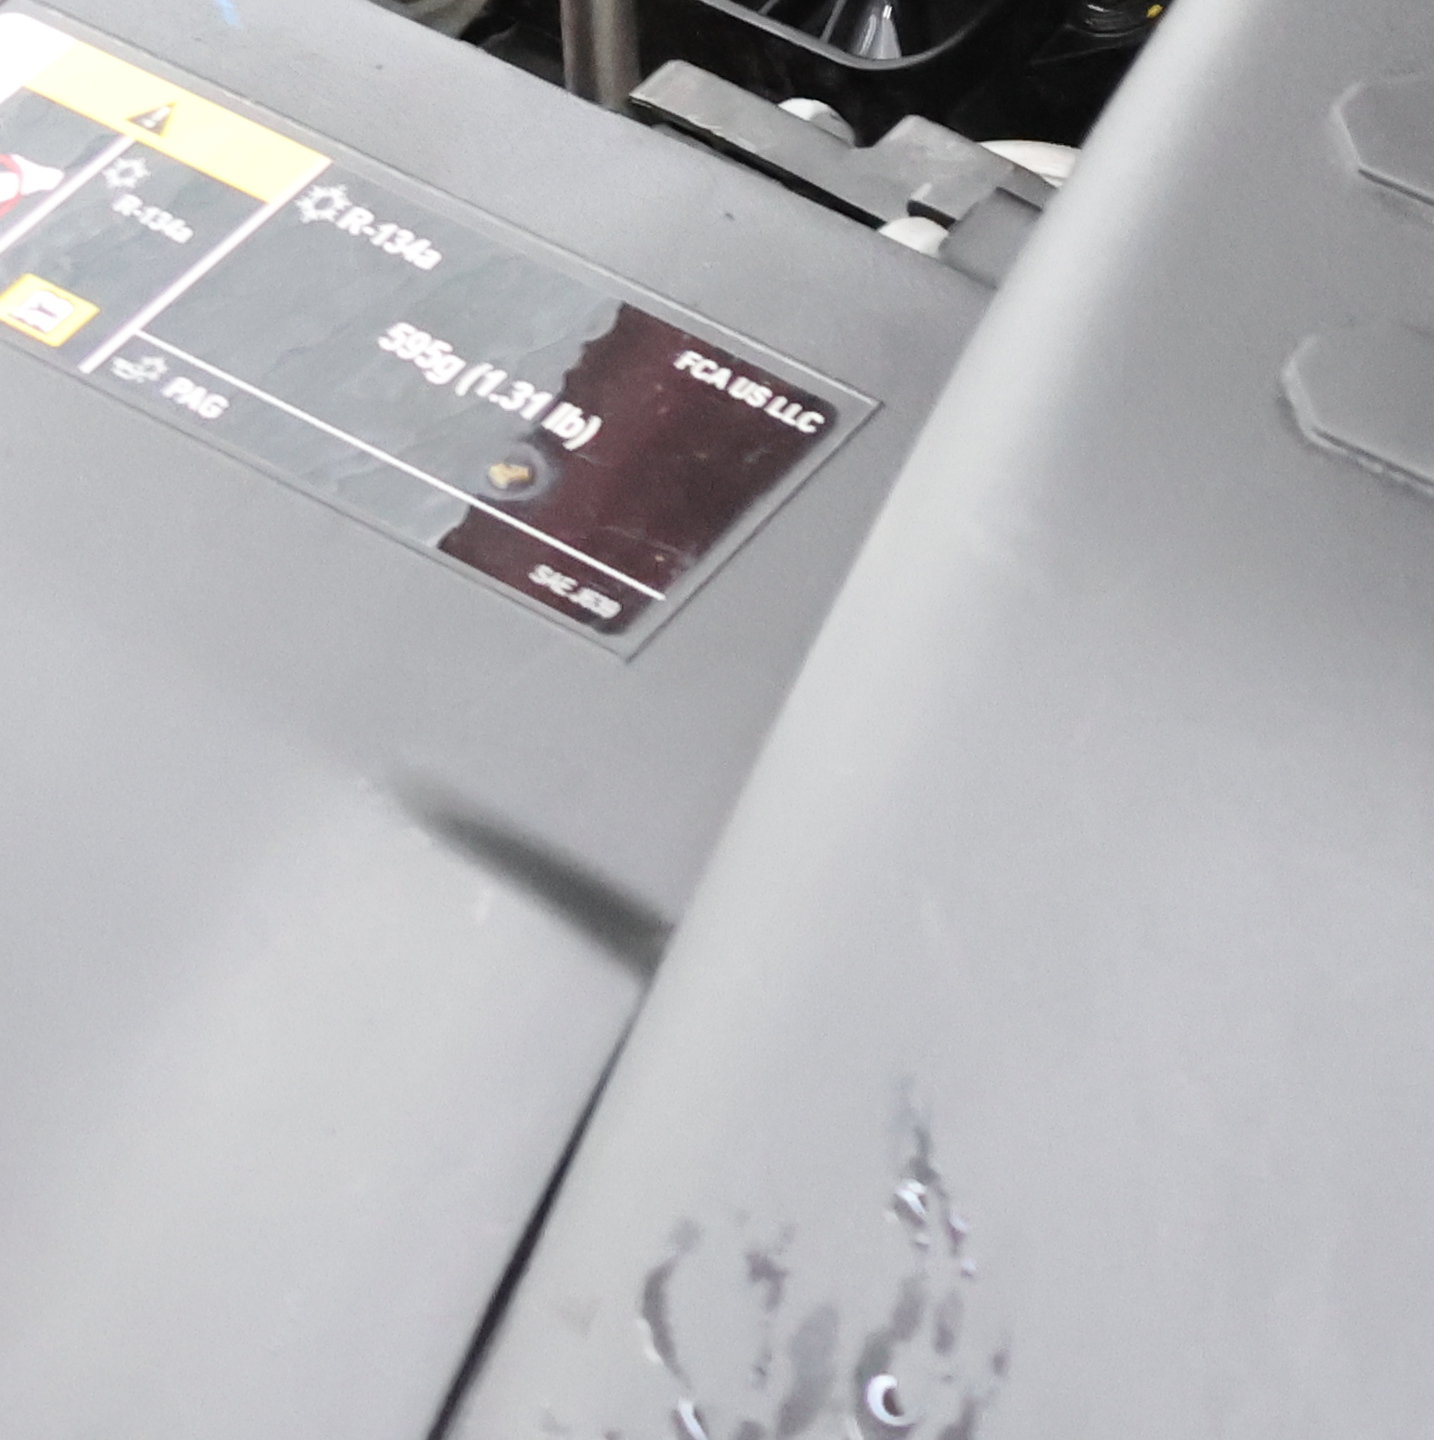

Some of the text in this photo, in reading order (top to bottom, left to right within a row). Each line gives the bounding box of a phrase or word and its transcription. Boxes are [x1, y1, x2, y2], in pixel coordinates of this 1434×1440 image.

[113, 193, 194, 243] R-134a
[336, 204, 442, 271] R-134a
[161, 376, 230, 419] PAG
[378, 322, 602, 451] 595g (1.31 lb)
[674, 350, 825, 435] FCA US LLC
